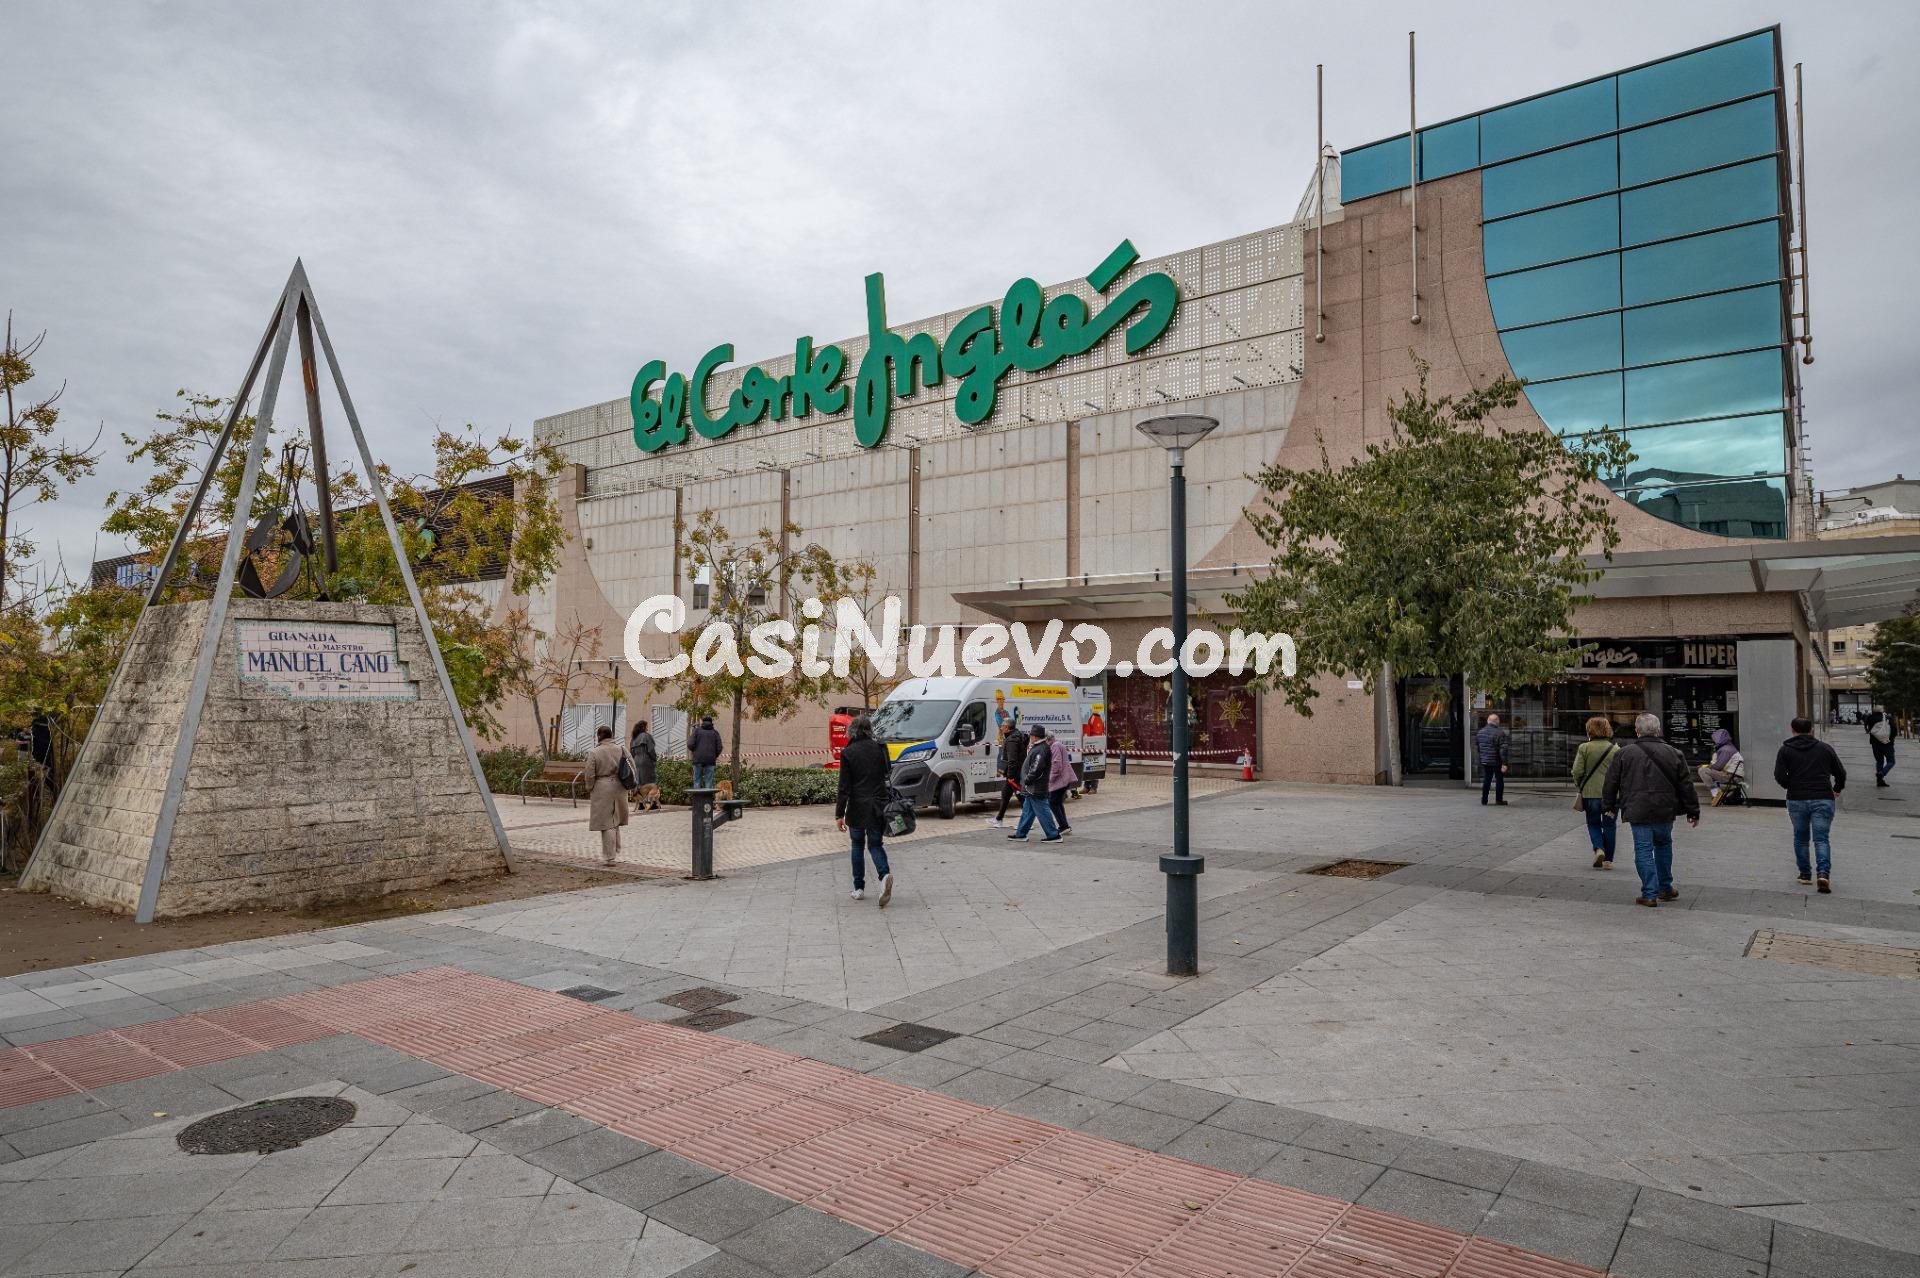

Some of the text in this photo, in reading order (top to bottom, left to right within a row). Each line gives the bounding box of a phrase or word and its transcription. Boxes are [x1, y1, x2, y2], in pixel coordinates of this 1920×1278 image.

[630, 238, 1180, 453] El Corte Inglés
[268, 631, 337, 643] GRANADA
[307, 643, 320, 651] AL
[248, 651, 389, 673] MANUEL CANO
[1683, 643, 1737, 666] HIPER
